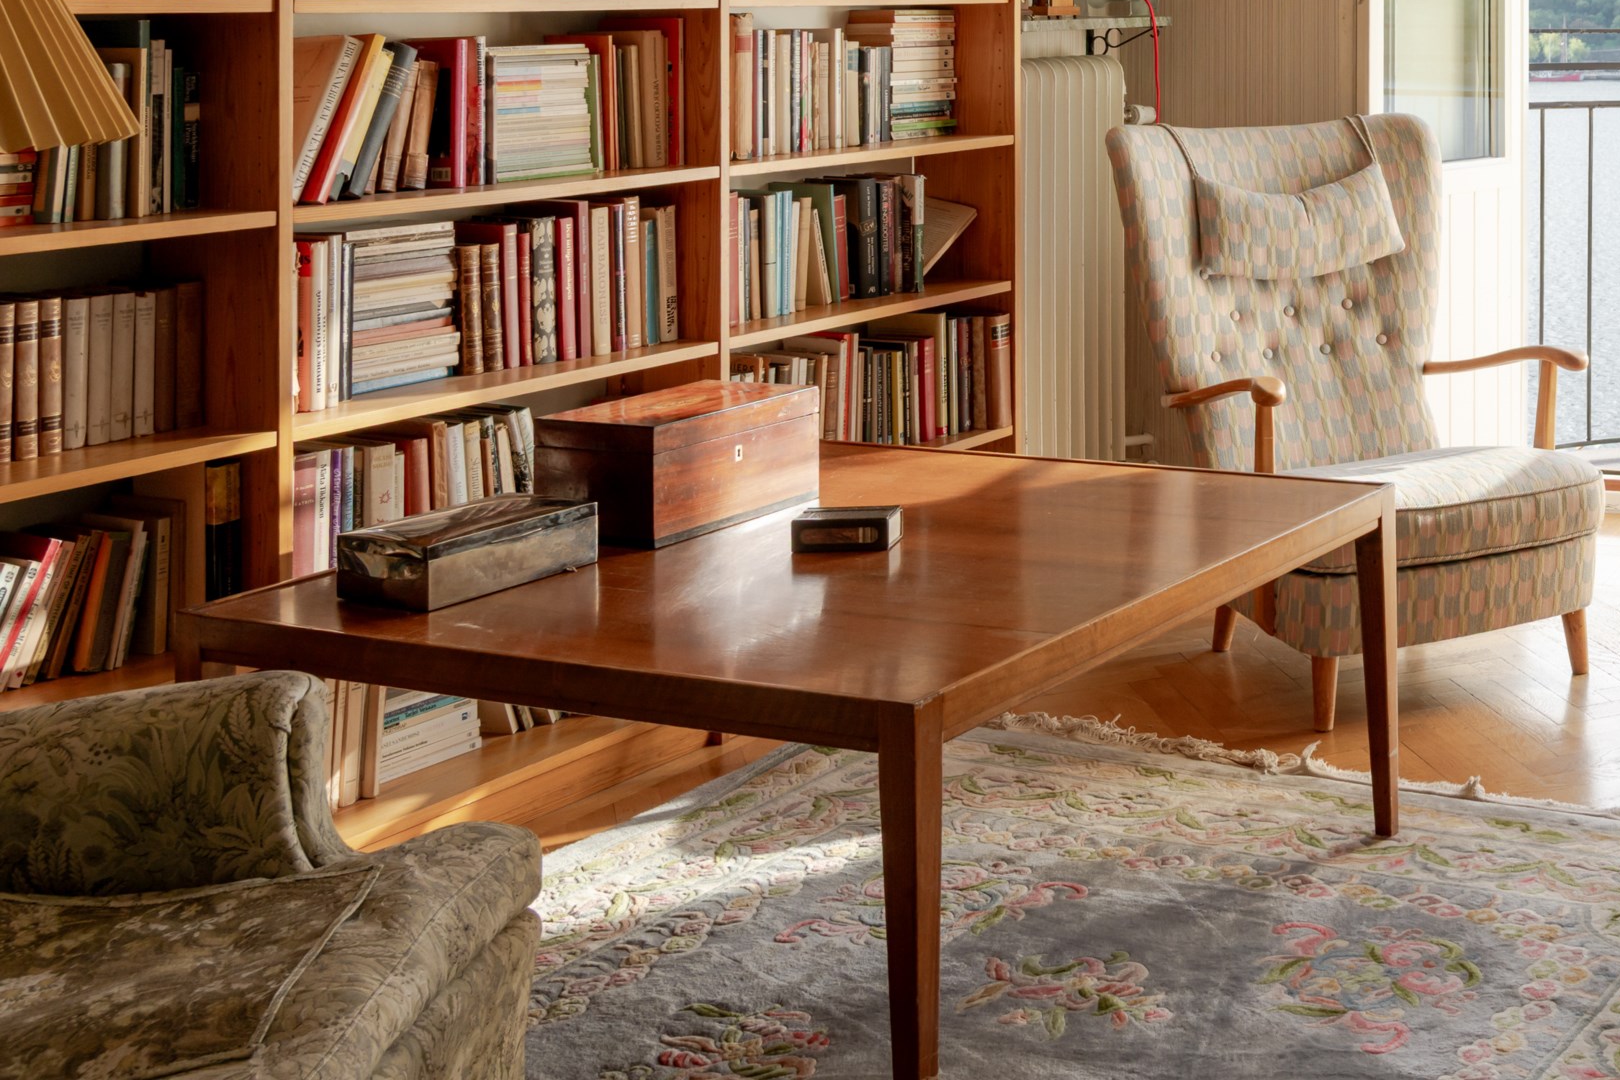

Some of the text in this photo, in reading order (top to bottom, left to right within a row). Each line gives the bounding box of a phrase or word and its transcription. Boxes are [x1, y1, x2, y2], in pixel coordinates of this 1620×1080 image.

[319, 60, 352, 121] WENNERHOLM
[306, 124, 325, 153] SVEN
[293, 153, 316, 190] HEDIN
[597, 216, 608, 325] DEAR BARONESS
[318, 486, 327, 519] Tikkanen
